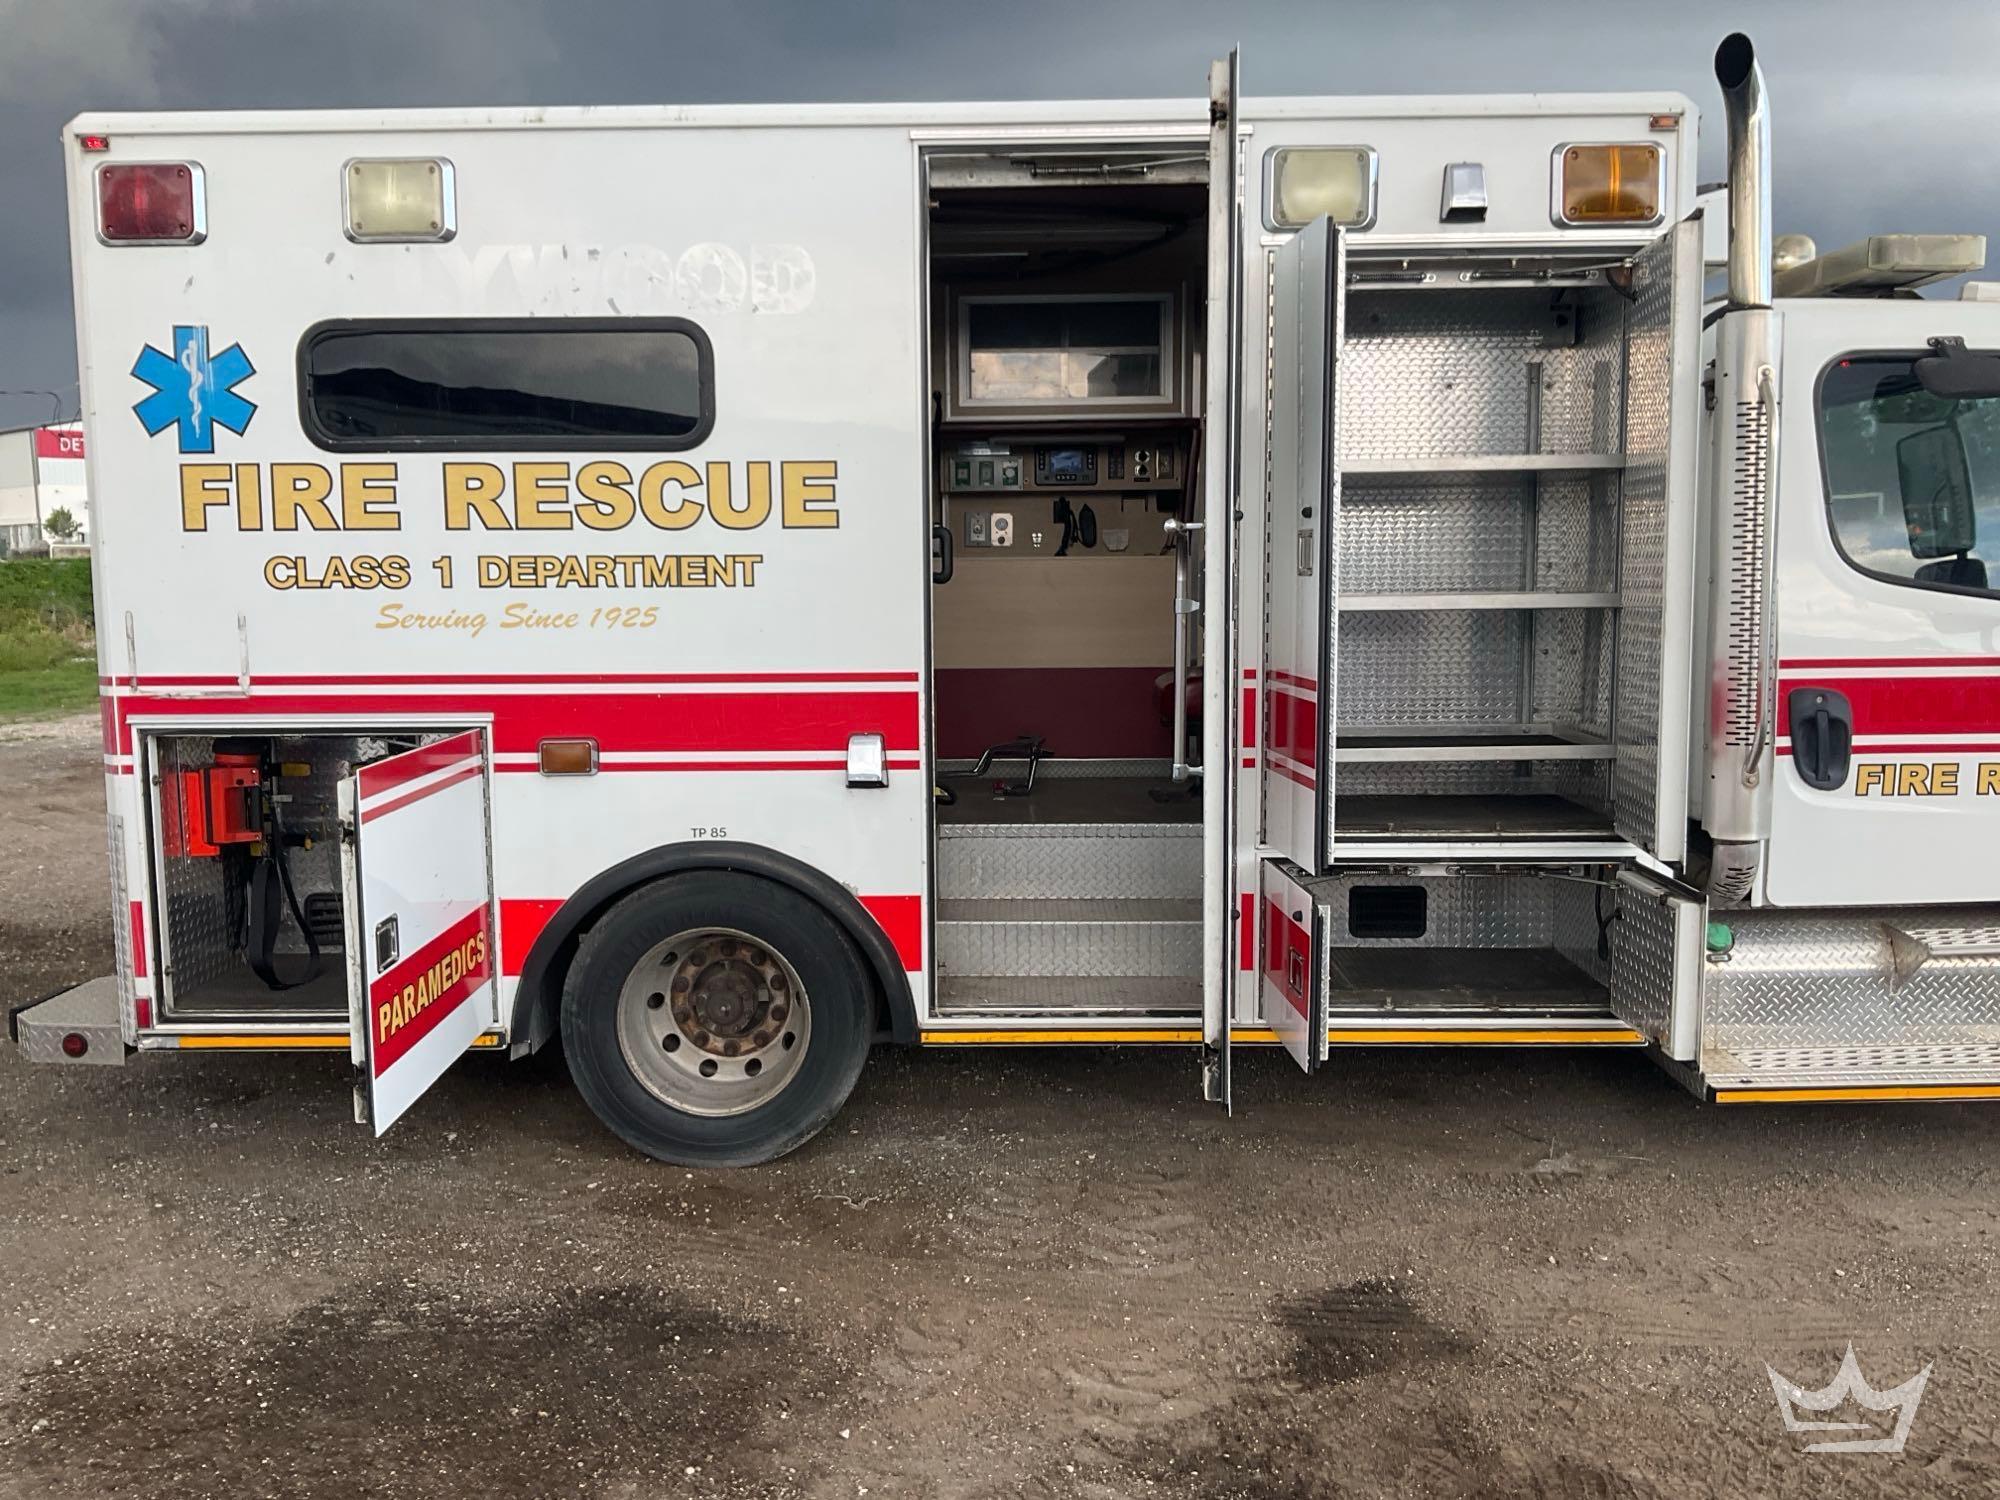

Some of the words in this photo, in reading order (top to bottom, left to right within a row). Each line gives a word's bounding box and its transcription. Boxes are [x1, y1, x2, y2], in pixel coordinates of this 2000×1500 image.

[180, 462, 401, 531] FIRE
[443, 461, 840, 530] RESCUE
[263, 555, 411, 589] CLASS
[432, 556, 454, 588] 1
[478, 554, 763, 588] DEPARTMENT
[375, 604, 487, 637] Serving
[499, 604, 579, 631] Since
[589, 605, 659, 632] 1925
[1855, 763, 1960, 796] FIRE
[690, 827, 707, 838] TP
[710, 827, 727, 838] 85
[378, 930, 486, 1045] PARAMEDICS
